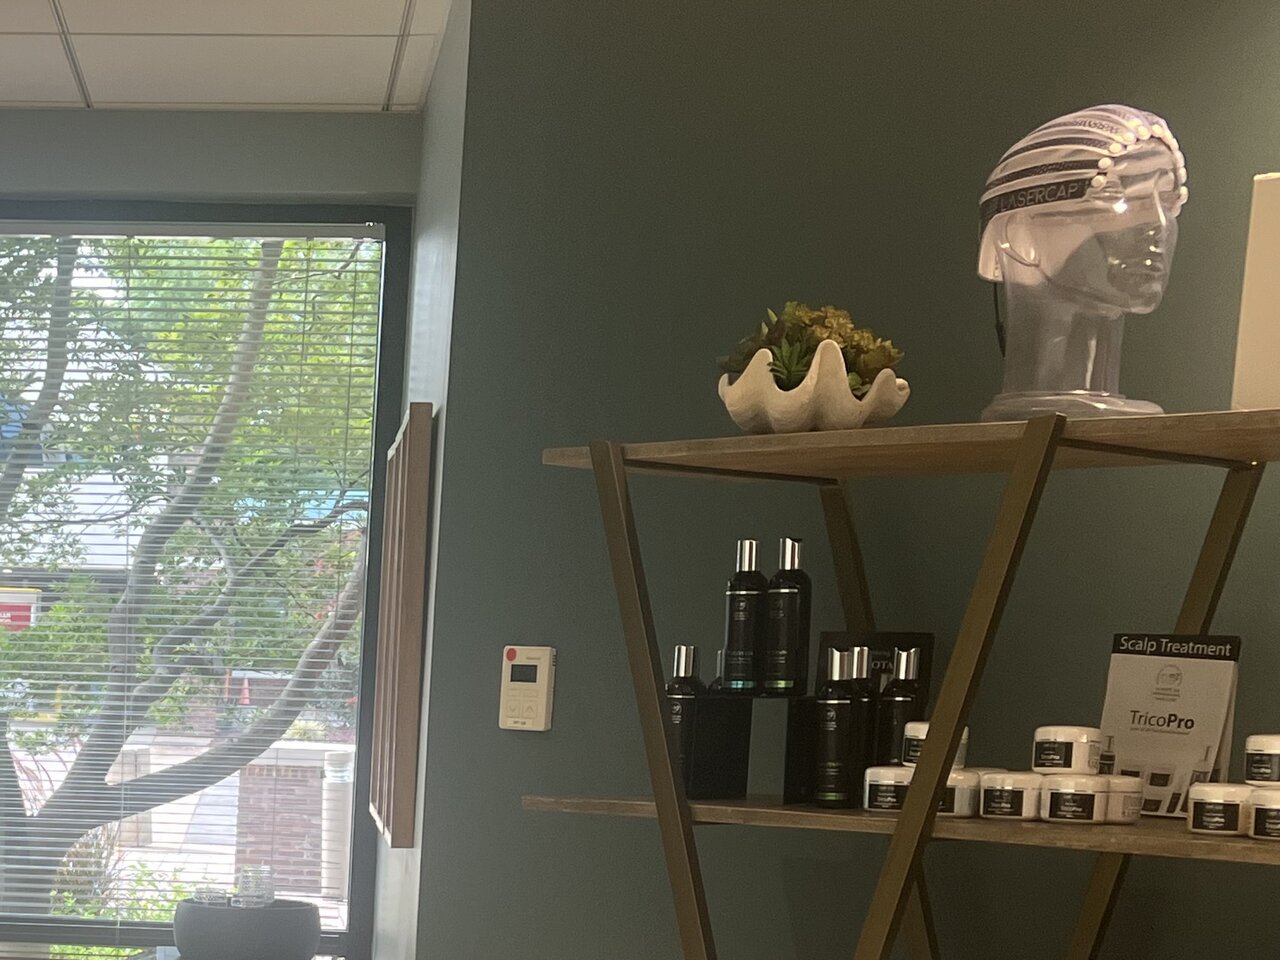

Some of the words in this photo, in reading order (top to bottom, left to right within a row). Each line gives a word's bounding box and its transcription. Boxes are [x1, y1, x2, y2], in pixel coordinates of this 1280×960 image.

[1000, 183, 1078, 211] LASERCAP
[1119, 636, 1157, 654] Scalp
[1160, 638, 1232, 657] Treatment
[1130, 710, 1195, 730] TricoPro
